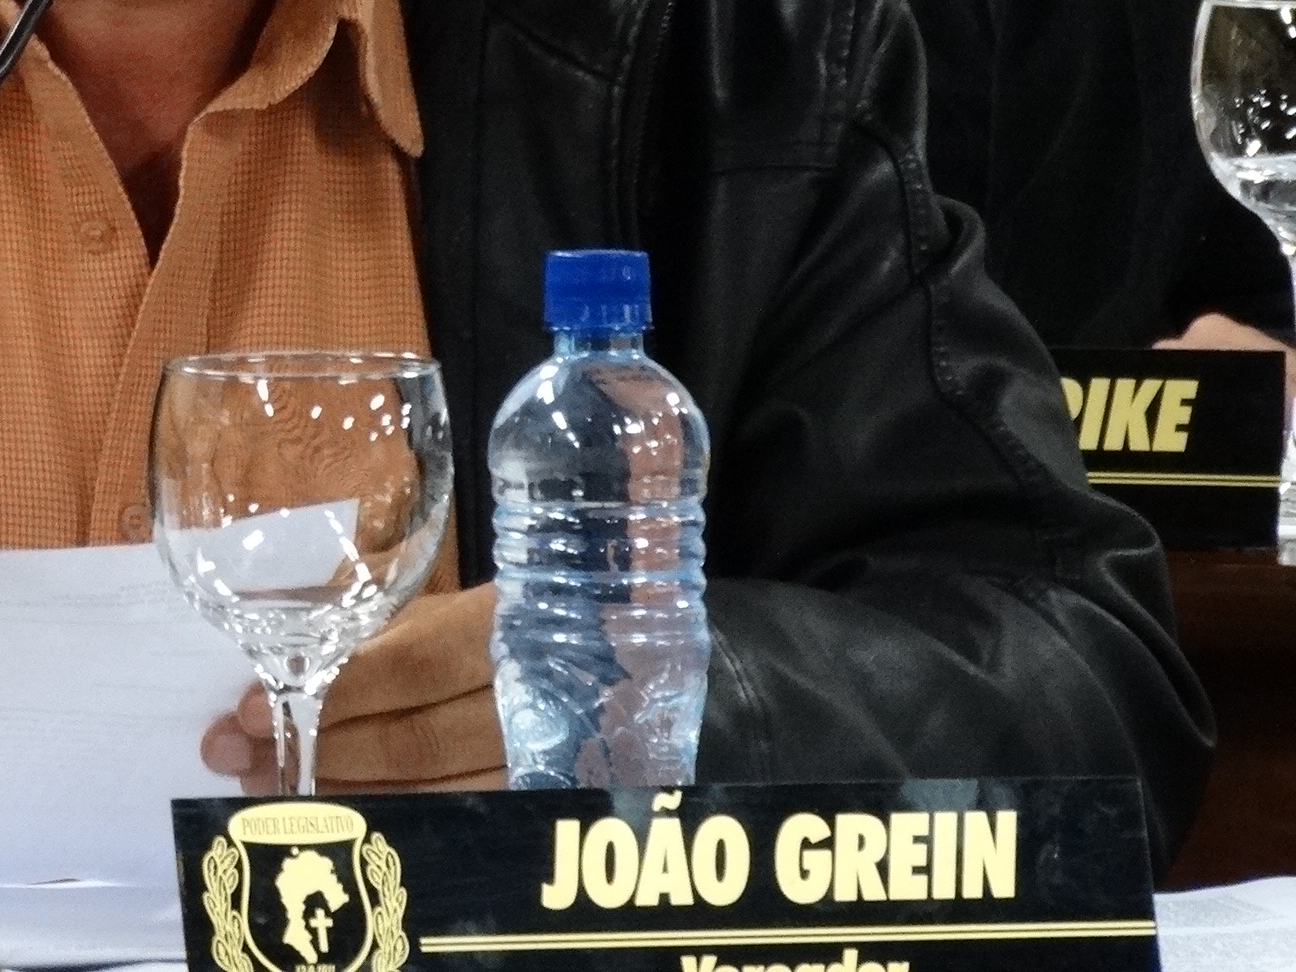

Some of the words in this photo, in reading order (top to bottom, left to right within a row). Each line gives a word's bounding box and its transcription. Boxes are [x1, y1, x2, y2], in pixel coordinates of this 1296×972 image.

[241, 817, 280, 836] PODER
[282, 815, 354, 835] LEGISLATIVO
[542, 791, 751, 910] JOÃO
[774, 811, 1017, 905] GREIN
